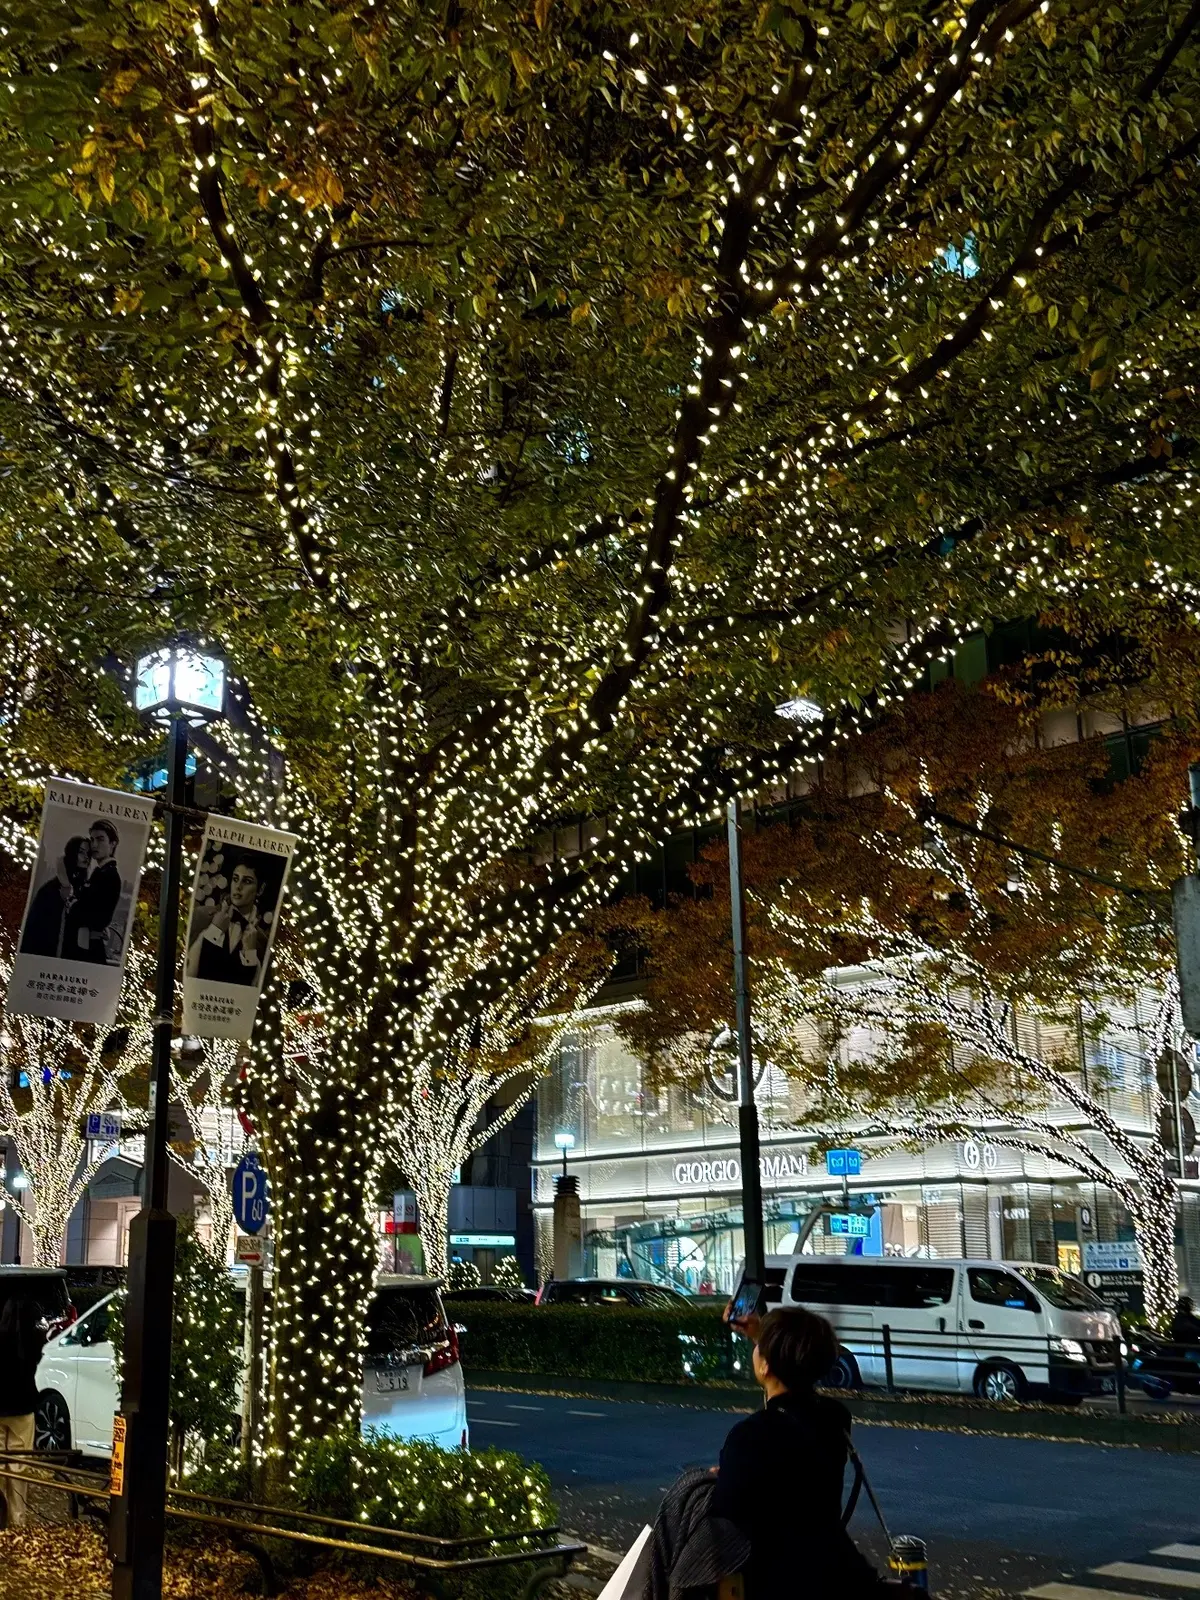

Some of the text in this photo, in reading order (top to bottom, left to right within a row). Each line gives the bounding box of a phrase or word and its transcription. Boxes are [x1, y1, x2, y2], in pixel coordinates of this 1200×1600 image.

[49, 790, 149, 821] RALPH LAUREN
[208, 826, 292, 854] RALPH LAUREN
[39, 972, 89, 985] HARAJUKU
[675, 1154, 807, 1184] GIORGIO RMANI
[241, 1171, 257, 1221] P
[252, 1199, 263, 1222] 60
